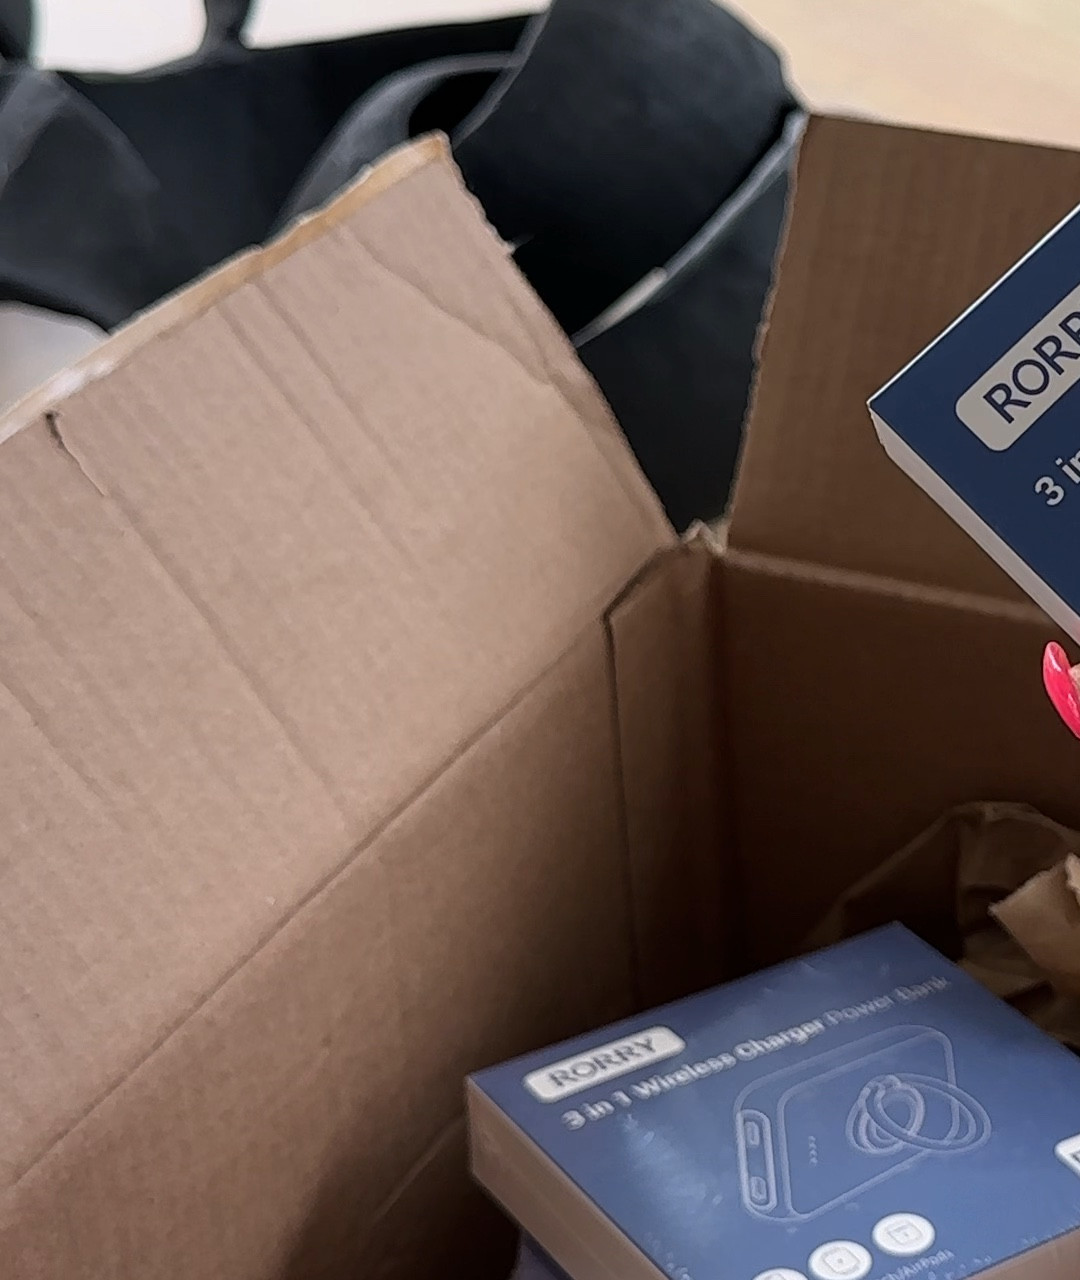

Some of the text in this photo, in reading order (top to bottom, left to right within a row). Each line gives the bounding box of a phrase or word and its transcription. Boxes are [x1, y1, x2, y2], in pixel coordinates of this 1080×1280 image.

[1034, 476, 1065, 506] 3
[549, 1035, 657, 1088] RORRY
[561, 974, 950, 1131] 3 in 1 Wireless Charger Power Bank
